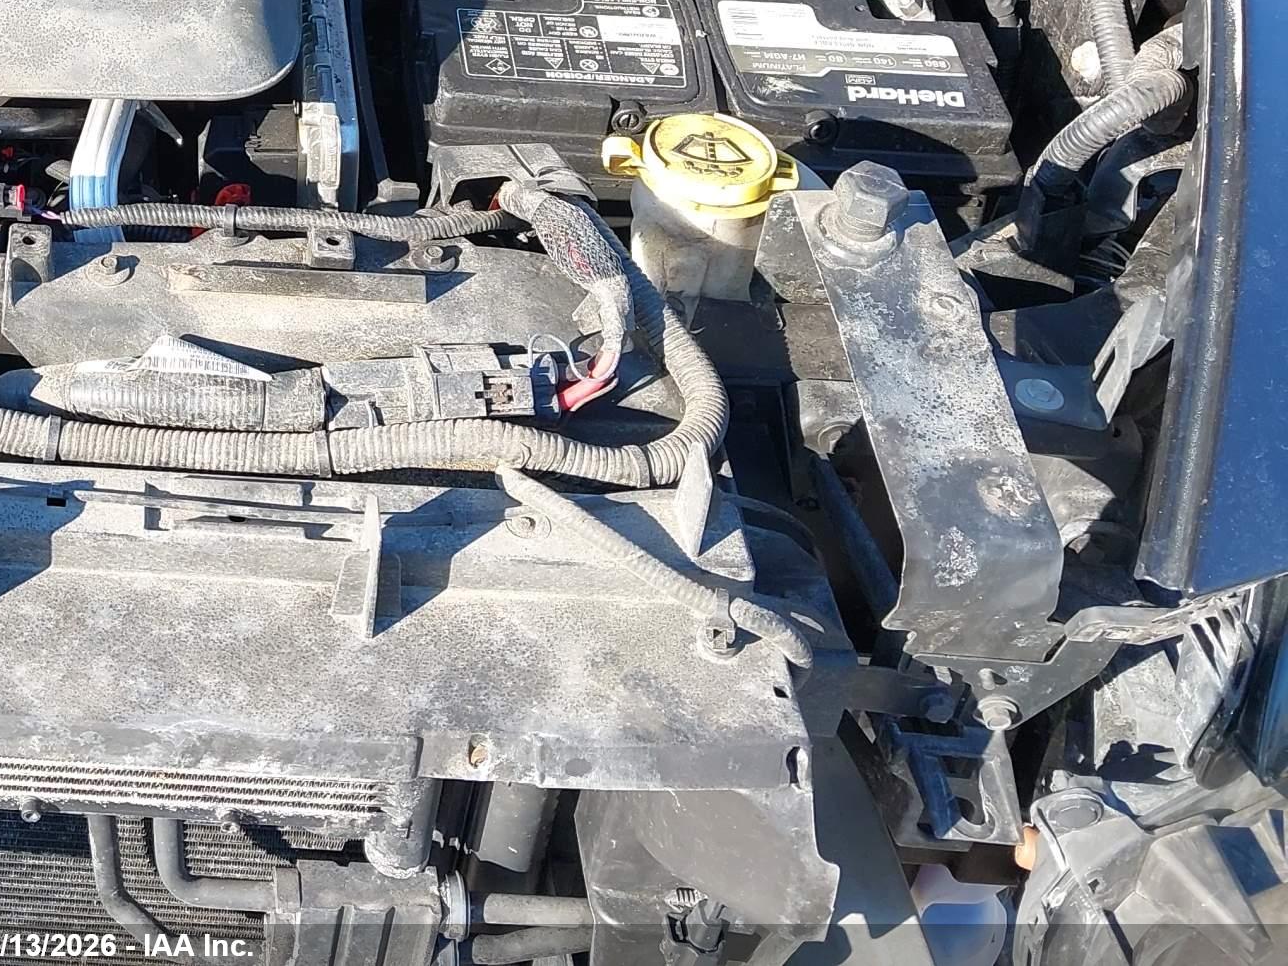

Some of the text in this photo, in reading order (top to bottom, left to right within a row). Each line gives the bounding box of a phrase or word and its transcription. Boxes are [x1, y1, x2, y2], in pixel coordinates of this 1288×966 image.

[828, 55, 844, 63] 80
[873, 57, 893, 66] 140
[752, 62, 806, 71] PLATINUM
[847, 85, 966, 107] DieHard
